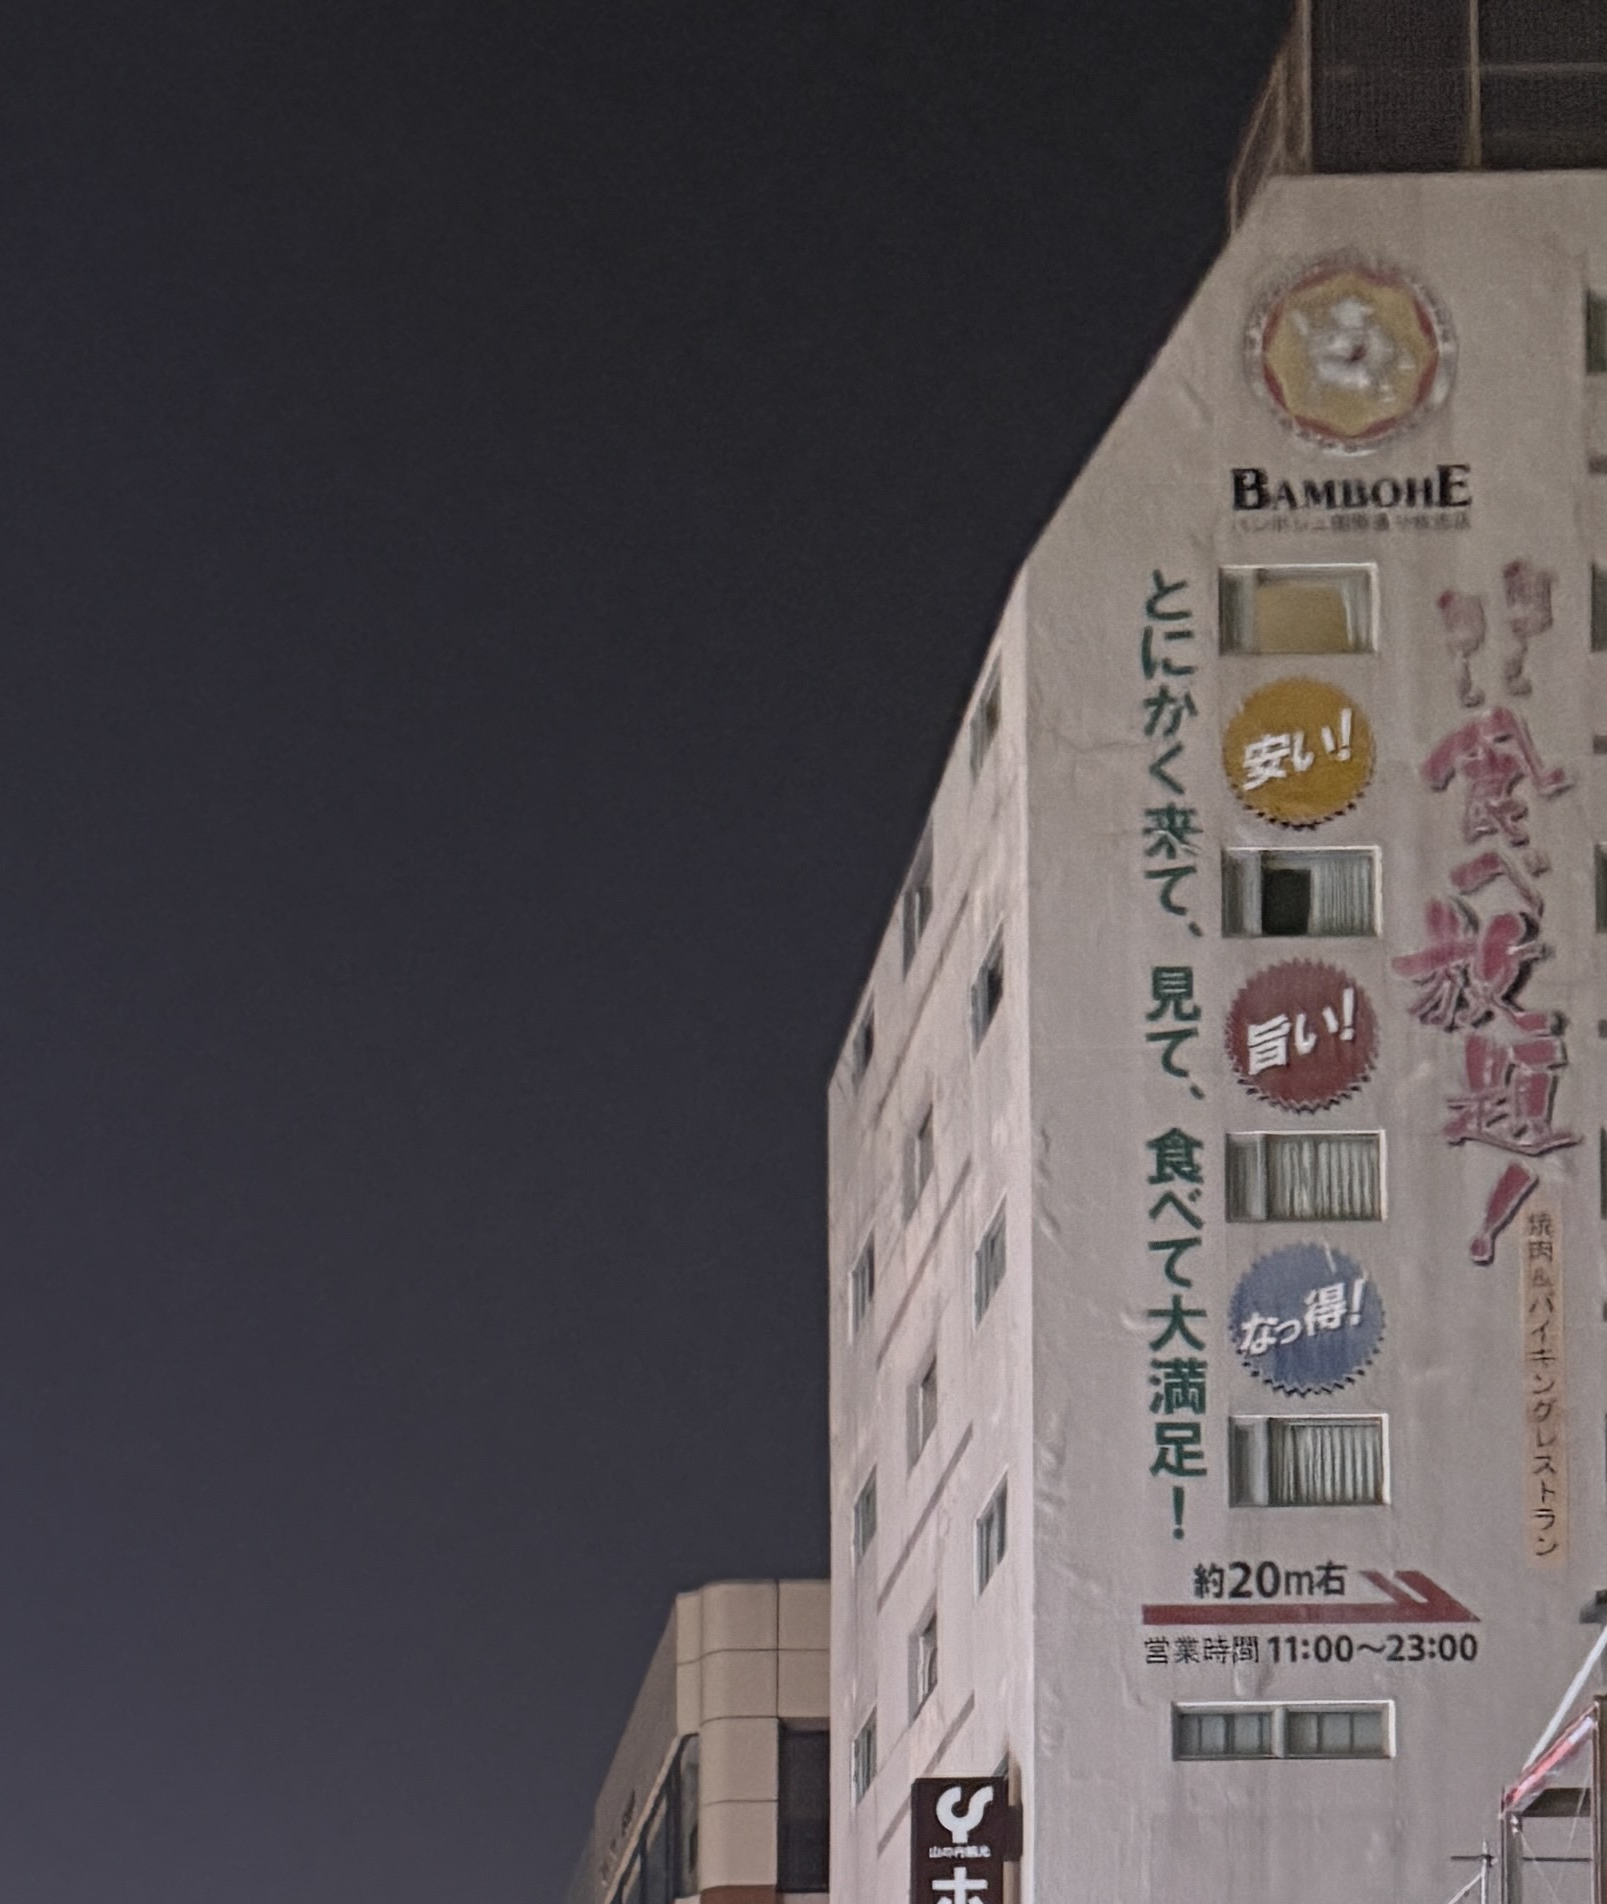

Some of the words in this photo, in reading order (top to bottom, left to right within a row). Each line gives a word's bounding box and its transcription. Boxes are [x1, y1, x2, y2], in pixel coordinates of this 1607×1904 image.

[1194, 1562, 1348, 1599] 約20m右
[1144, 1636, 1260, 1664] 営業時間
